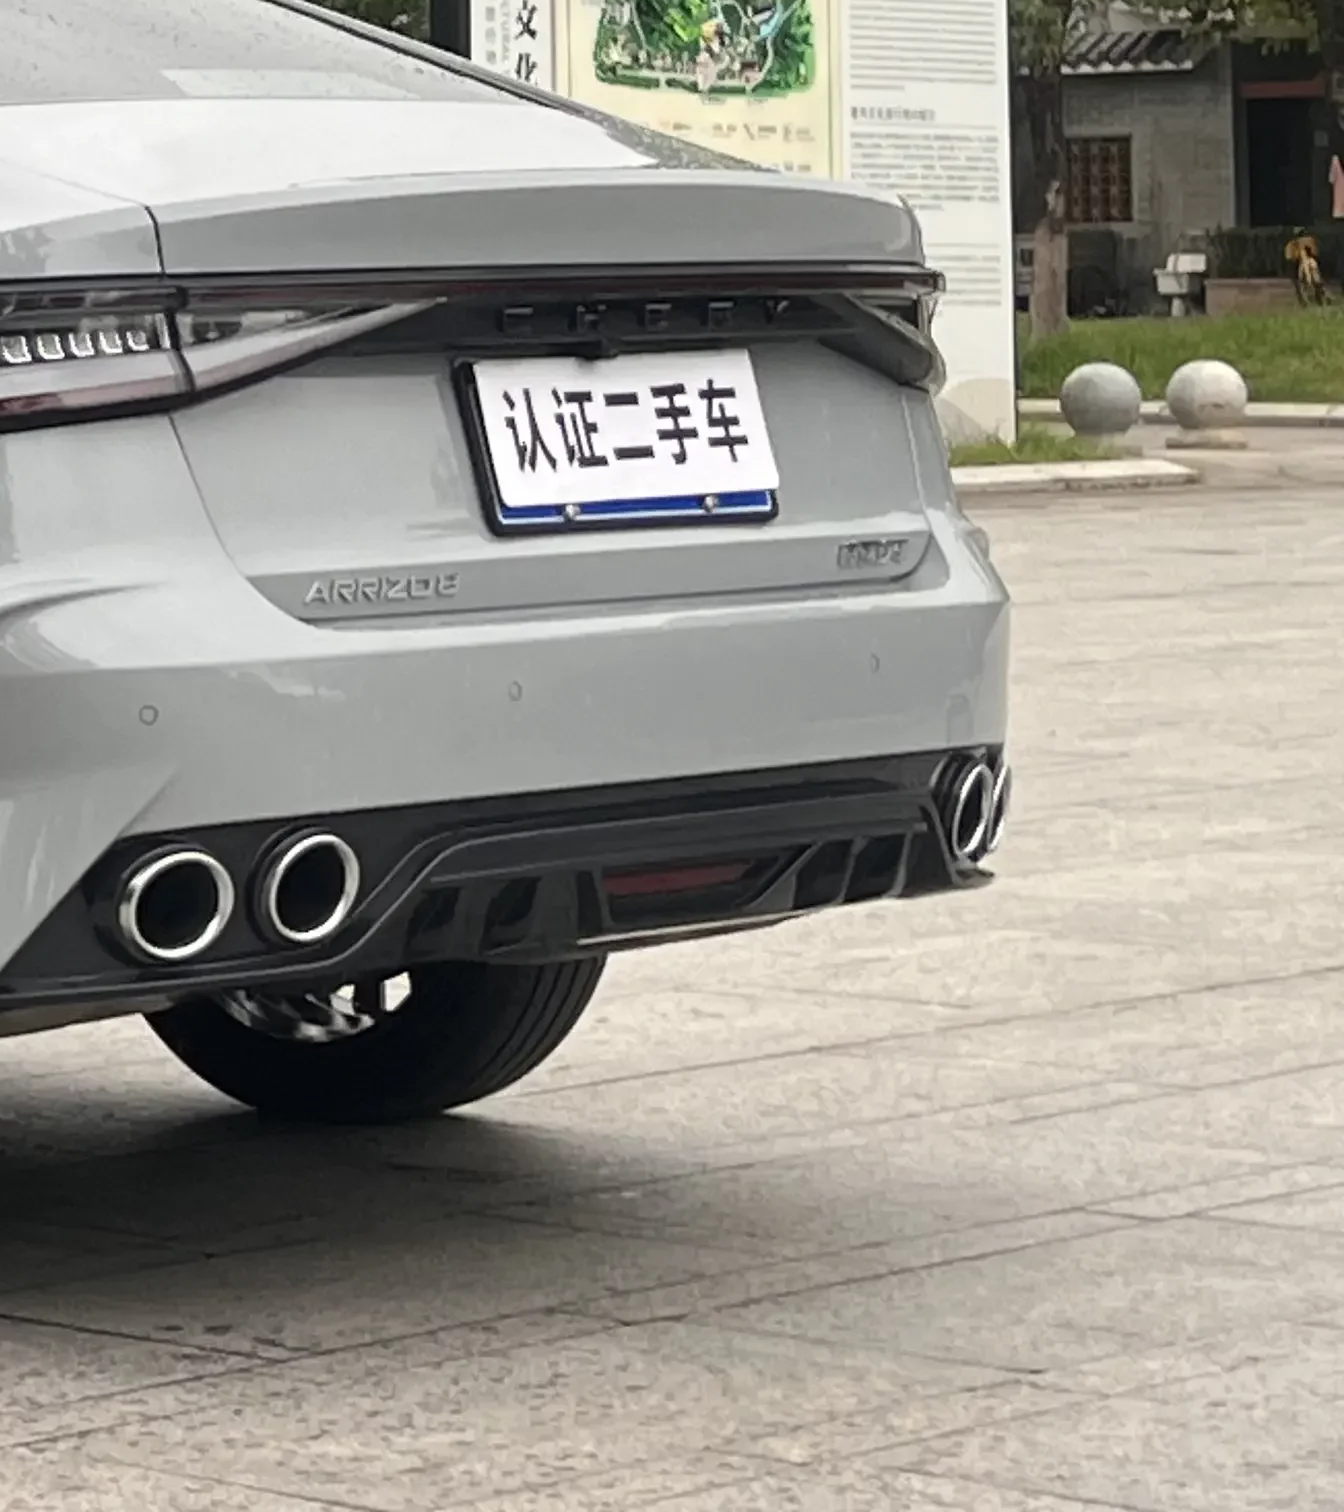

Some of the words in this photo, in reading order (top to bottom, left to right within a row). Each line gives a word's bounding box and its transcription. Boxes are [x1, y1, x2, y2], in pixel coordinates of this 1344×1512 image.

[502, 378, 748, 472] 认证二手车
